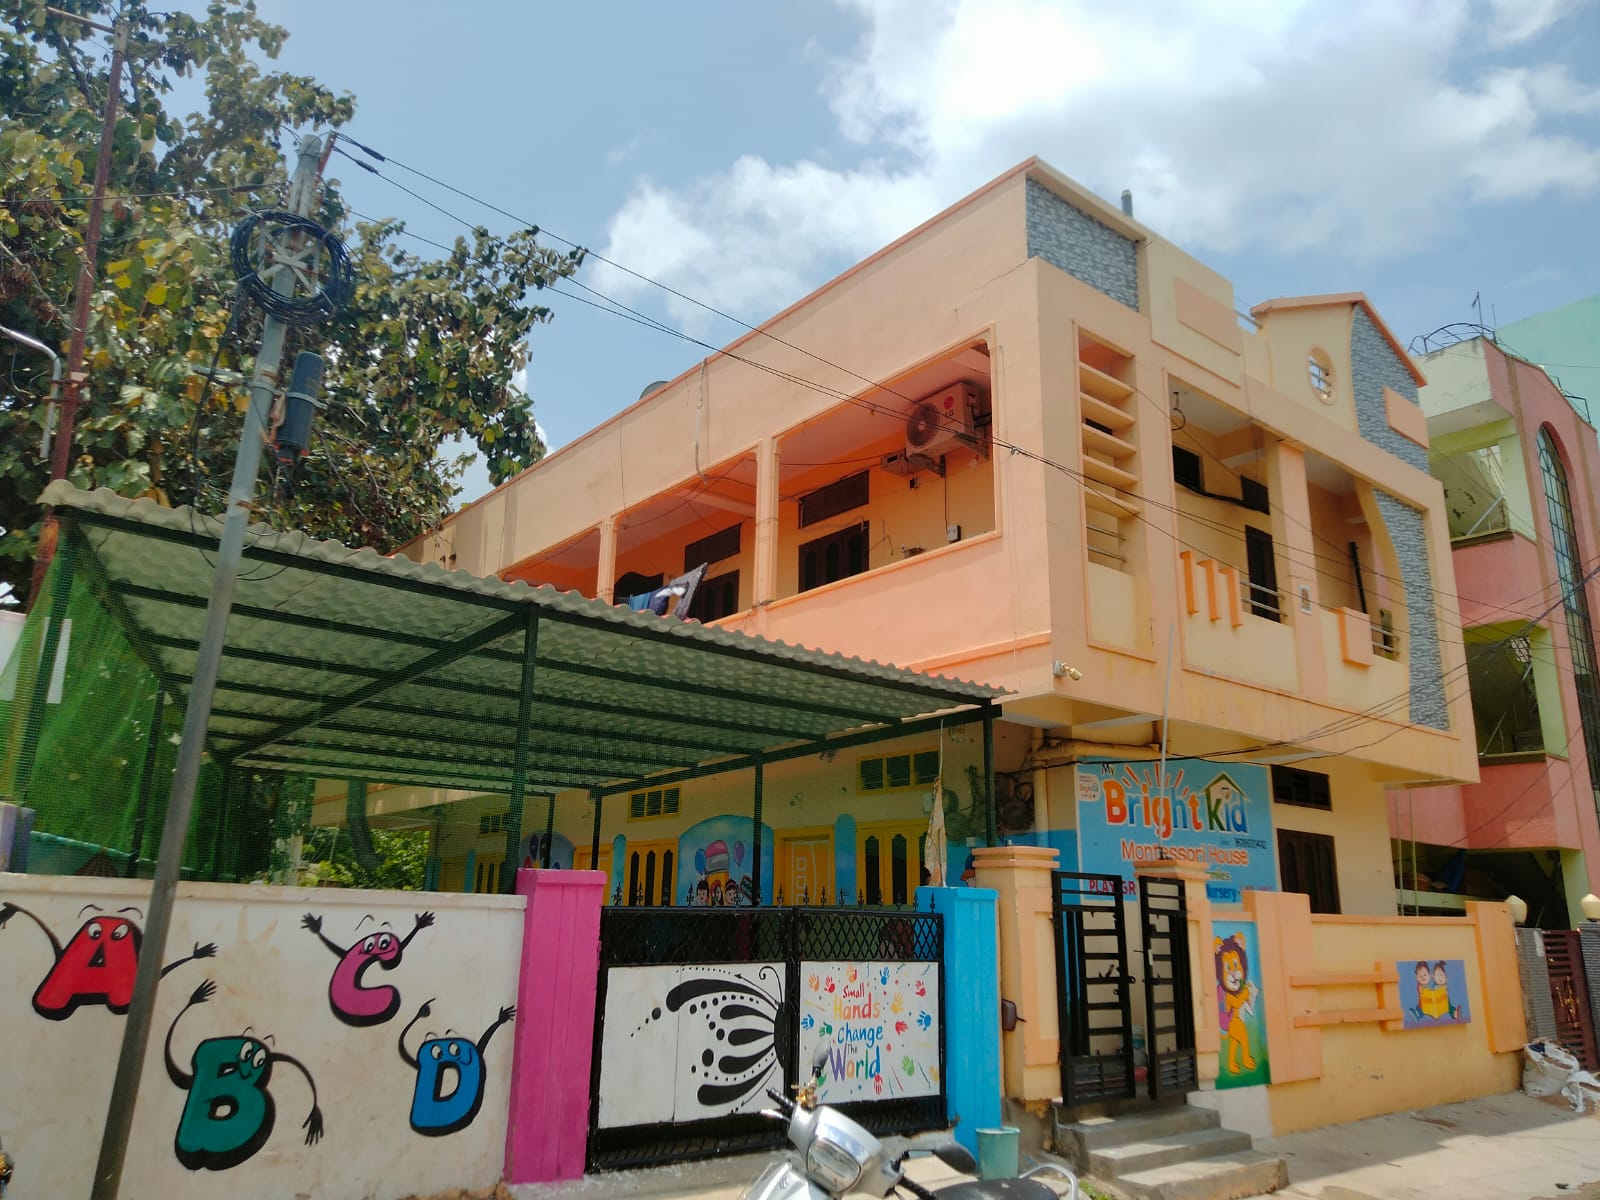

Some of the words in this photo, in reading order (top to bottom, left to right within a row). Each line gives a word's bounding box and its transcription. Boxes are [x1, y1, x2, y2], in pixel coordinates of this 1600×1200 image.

[1101, 763, 1115, 776] My
[1102, 779, 1203, 839] Bright
[1121, 838, 1205, 864] Montessori
[1207, 845, 1249, 866] House
[32, 915, 141, 1021] A
[328, 930, 402, 1028] C
[834, 993, 881, 1020] Hands
[843, 982, 864, 998] Small
[830, 1043, 880, 1081] World
[848, 1043, 858, 1055] The
[174, 1035, 277, 1171] B
[409, 1036, 487, 1137] D
